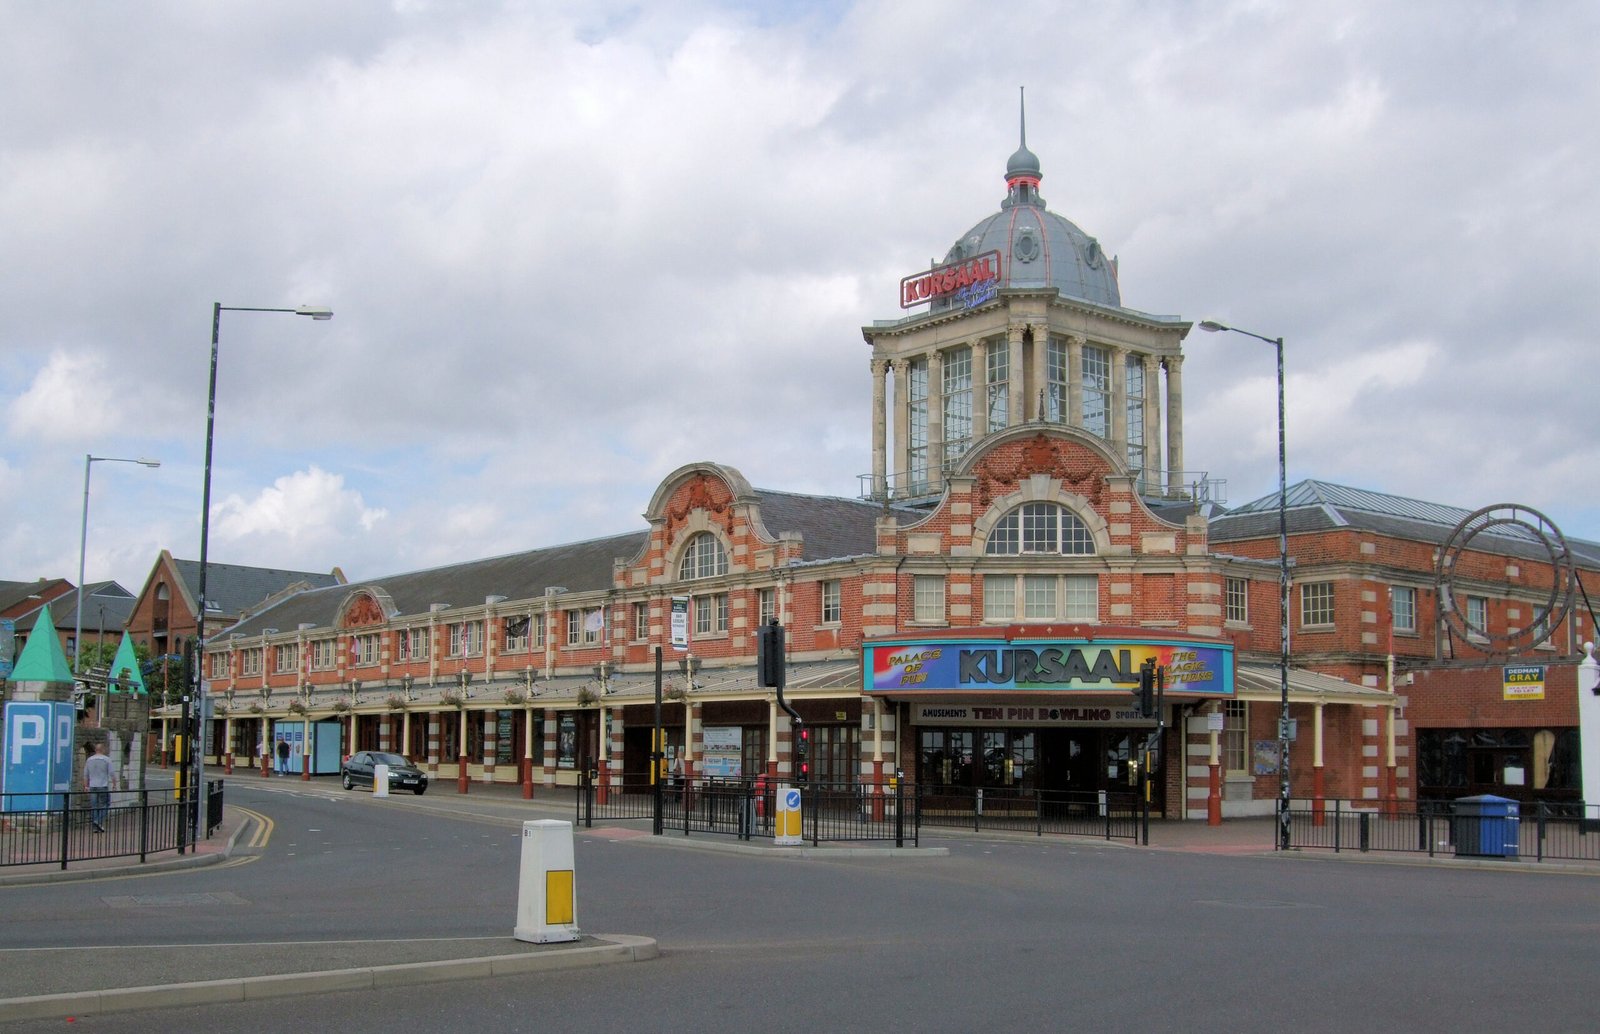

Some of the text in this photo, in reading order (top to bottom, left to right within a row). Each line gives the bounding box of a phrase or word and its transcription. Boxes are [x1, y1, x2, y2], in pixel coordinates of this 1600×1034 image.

[905, 258, 994, 303] KURSAAL
[888, 648, 942, 666] PALACE
[1172, 651, 1197, 662] THE
[904, 663, 923, 674] OF
[959, 649, 1140, 684] KURSAAL
[1163, 661, 1206, 674] MAGIC
[901, 672, 928, 687] FUN
[922, 709, 967, 718] AMUSEMENTS
[972, 707, 1003, 720] TEN
[1007, 708, 1034, 720] PIN
[1039, 708, 1111, 721] BOWLING
[11, 714, 45, 765] P
[56, 715, 71, 764] P
